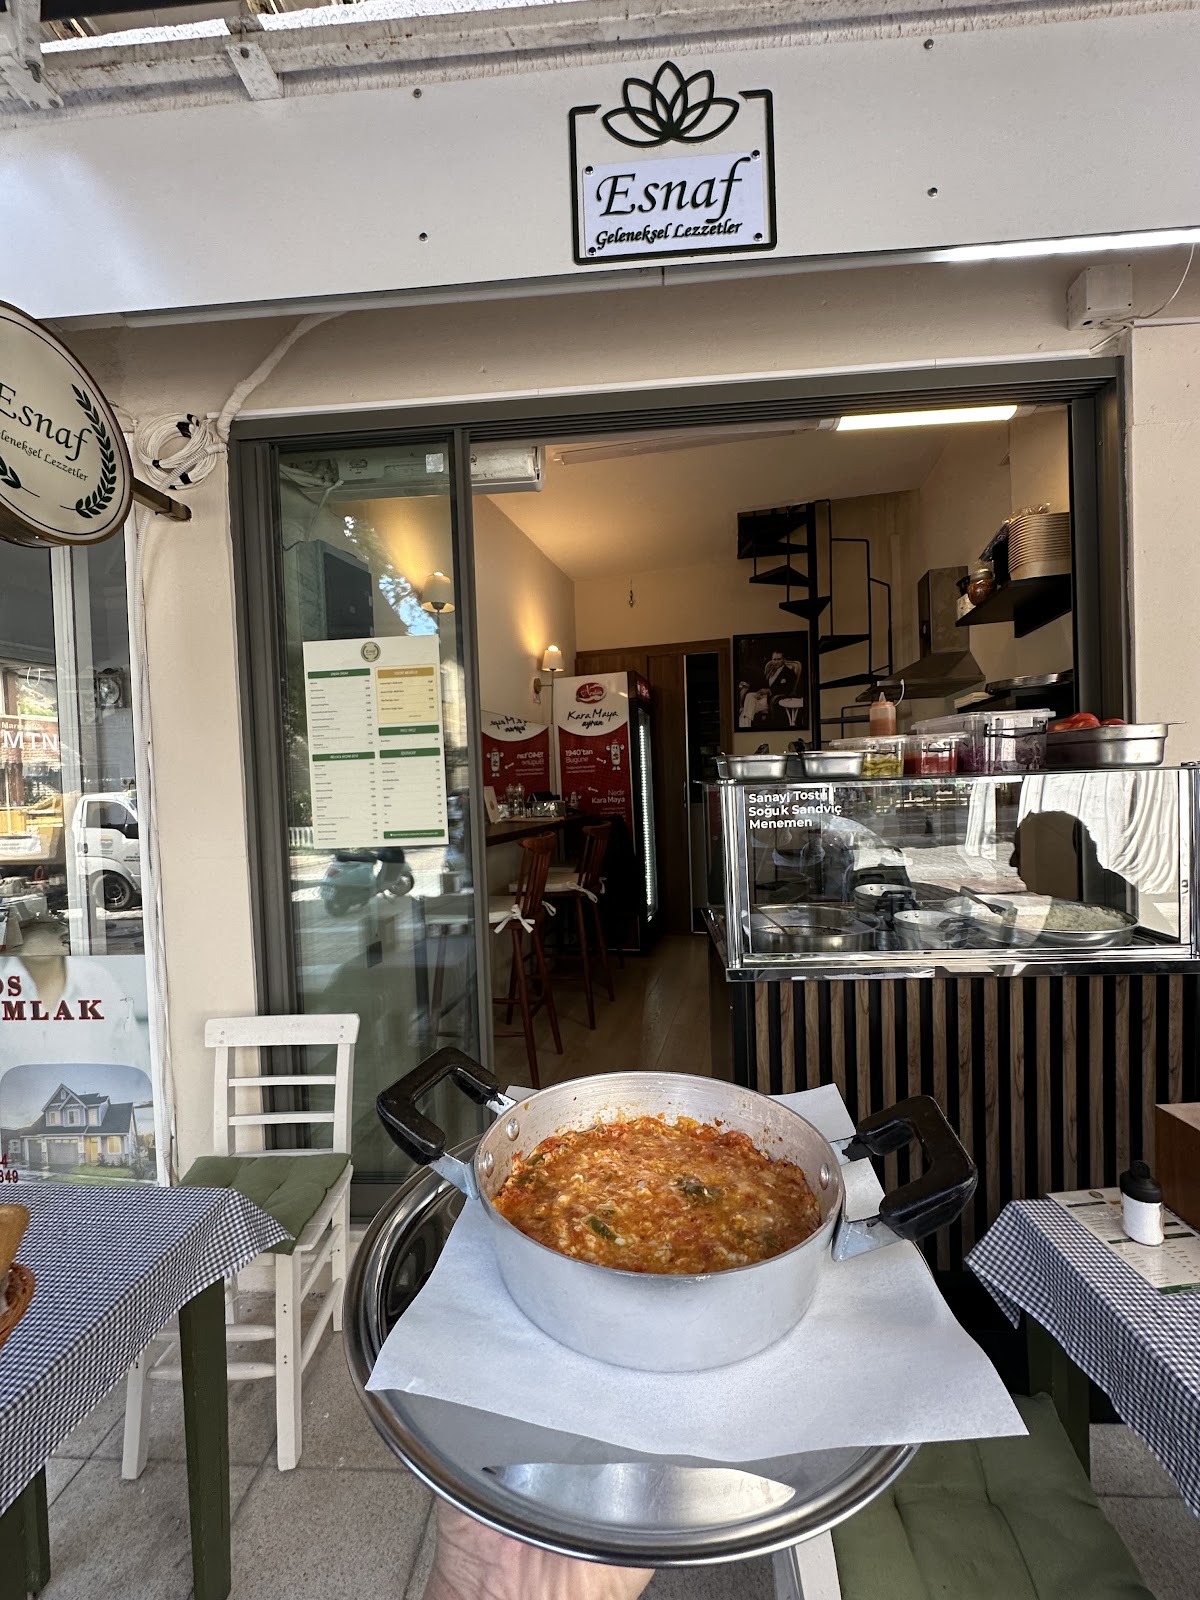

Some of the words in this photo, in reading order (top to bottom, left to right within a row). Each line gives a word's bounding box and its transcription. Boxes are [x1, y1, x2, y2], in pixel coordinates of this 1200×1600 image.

[596, 156, 751, 223] Esnaf
[596, 223, 671, 250] Geleneksel
[672, 218, 743, 238] Lezzetler
[0, 430, 43, 459] leneksel
[44, 453, 89, 481] Lezzetler
[567, 710, 591, 721] Kara
[593, 708, 619, 723] Maya
[582, 719, 604, 730] ayran
[591, 796, 607, 804] Kara
[607, 796, 625, 805] Maya
[748, 792, 791, 804] Sanayi
[748, 804, 790, 818] Soğuk
[791, 803, 842, 816] Sandviç
[749, 818, 813, 829] Menemen
[2, 999, 104, 1021] MLAK
